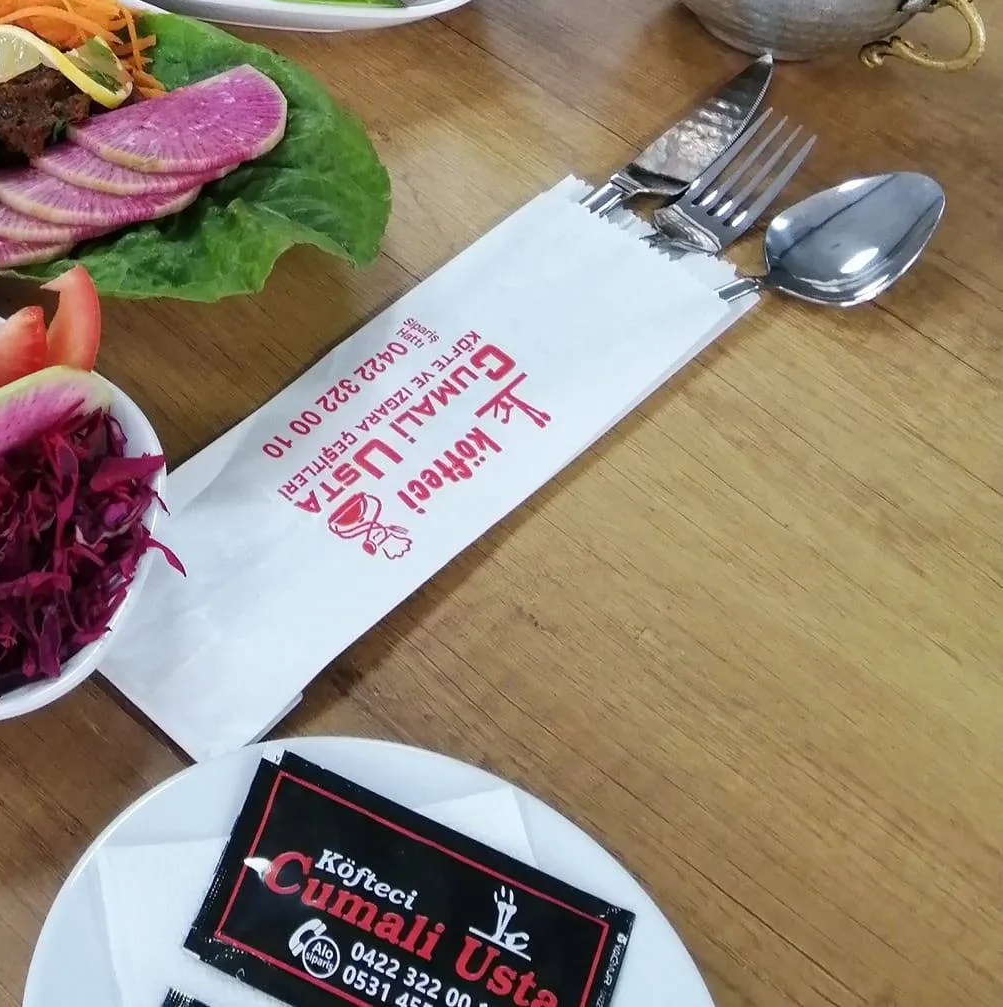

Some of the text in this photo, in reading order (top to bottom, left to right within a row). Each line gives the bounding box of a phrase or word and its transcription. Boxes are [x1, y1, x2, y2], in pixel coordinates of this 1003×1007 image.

[431, 330, 482, 373] KÖFTE
[262, 342, 408, 459] 0422 322 00 10
[410, 369, 436, 389] VE
[355, 383, 414, 432] IZGARA
[314, 848, 418, 911] Köfteci
[264, 850, 446, 961] Cumali
[311, 941, 334, 961] Alo
[350, 941, 472, 1007] 0422 322 00
[342, 964, 434, 1007] 0531 45
